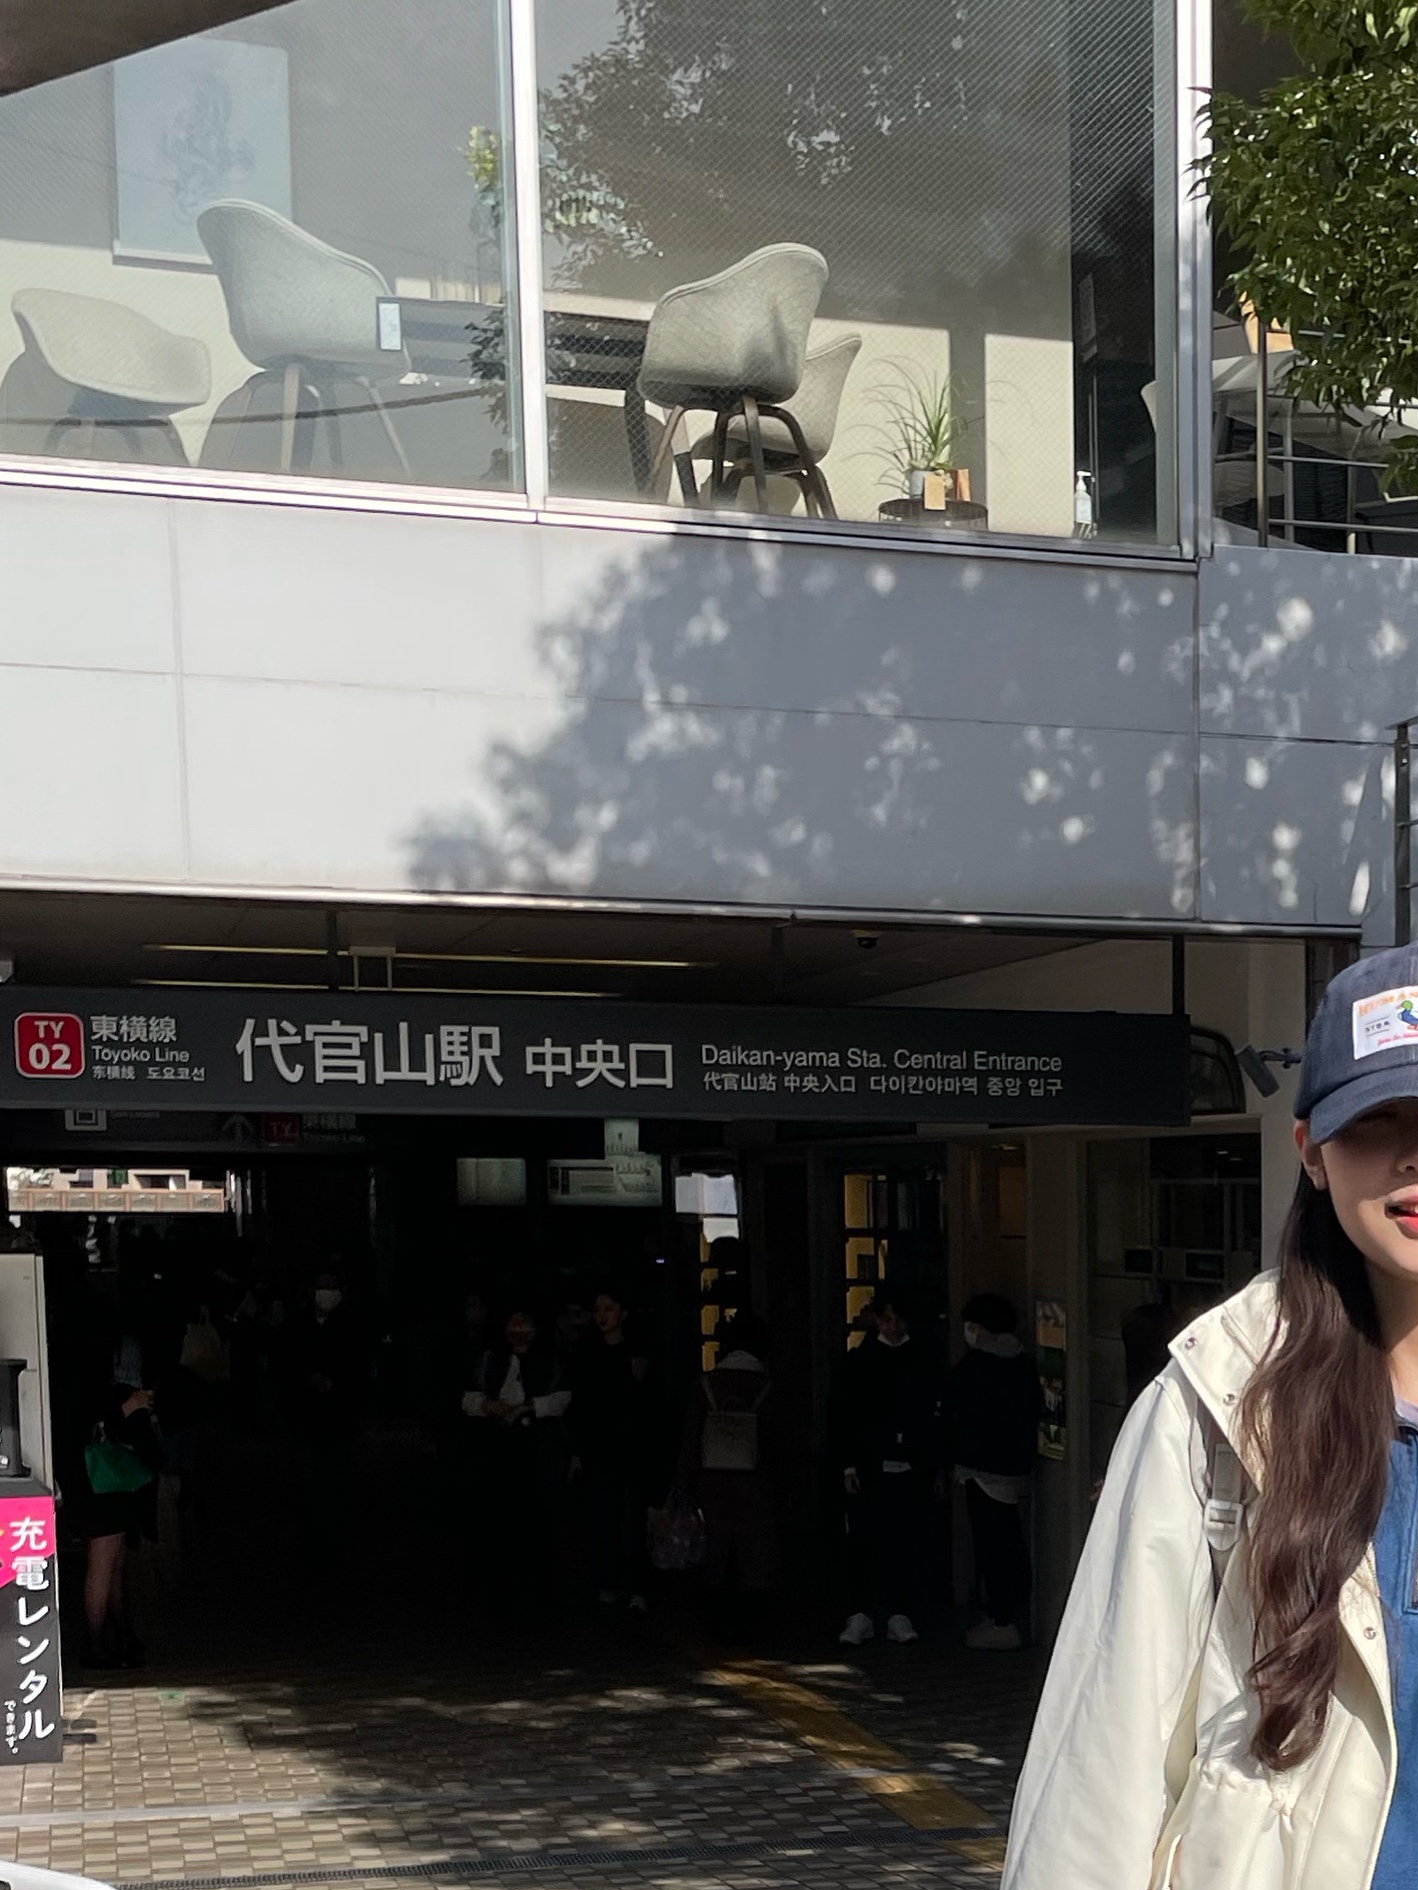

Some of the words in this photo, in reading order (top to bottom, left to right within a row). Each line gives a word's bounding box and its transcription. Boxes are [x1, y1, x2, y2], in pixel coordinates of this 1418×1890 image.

[34, 1020, 65, 1039] TY
[90, 1015, 178, 1043] 東横線
[28, 1042, 72, 1070] 02
[91, 1045, 150, 1064] Toyoko
[155, 1047, 190, 1062] Line
[235, 1018, 504, 1086] 代官山駅
[525, 1037, 674, 1089] 中央口
[701, 1044, 840, 1071] Daikan-yama
[847, 1047, 887, 1068] Sta.
[893, 1049, 968, 1070] Central
[973, 1051, 1063, 1072] Entrance
[703, 1071, 777, 1092] 代官山站
[784, 1073, 856, 1093] 中央入口
[870, 1075, 978, 1096] 다이칸야마역
[987, 1077, 1023, 1097] 중앙
[1028, 1078, 1063, 1097] 입구
[9, 1516, 53, 1740] 充電レンタル
